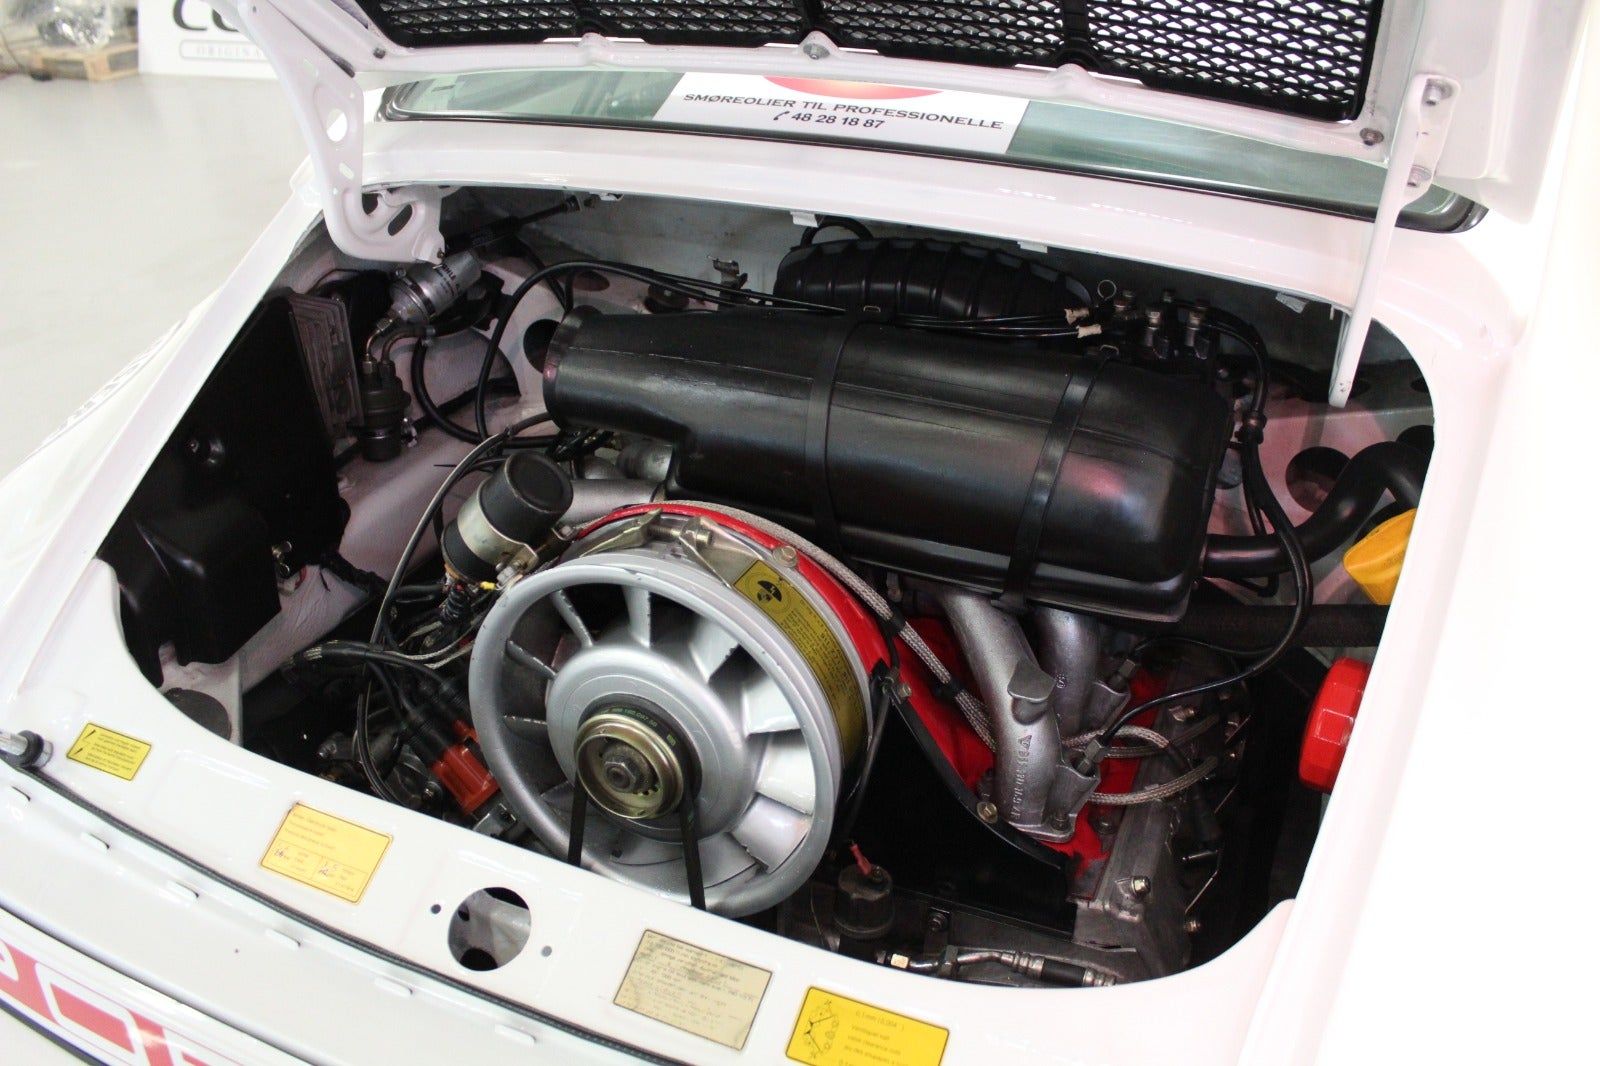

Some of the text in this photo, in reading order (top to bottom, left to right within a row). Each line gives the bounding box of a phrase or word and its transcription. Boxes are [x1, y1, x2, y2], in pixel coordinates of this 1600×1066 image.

[683, 93, 1005, 130] SMØREOLIER TIL PROFESSIONELLE
[791, 112, 886, 129] 48 28 18 87
